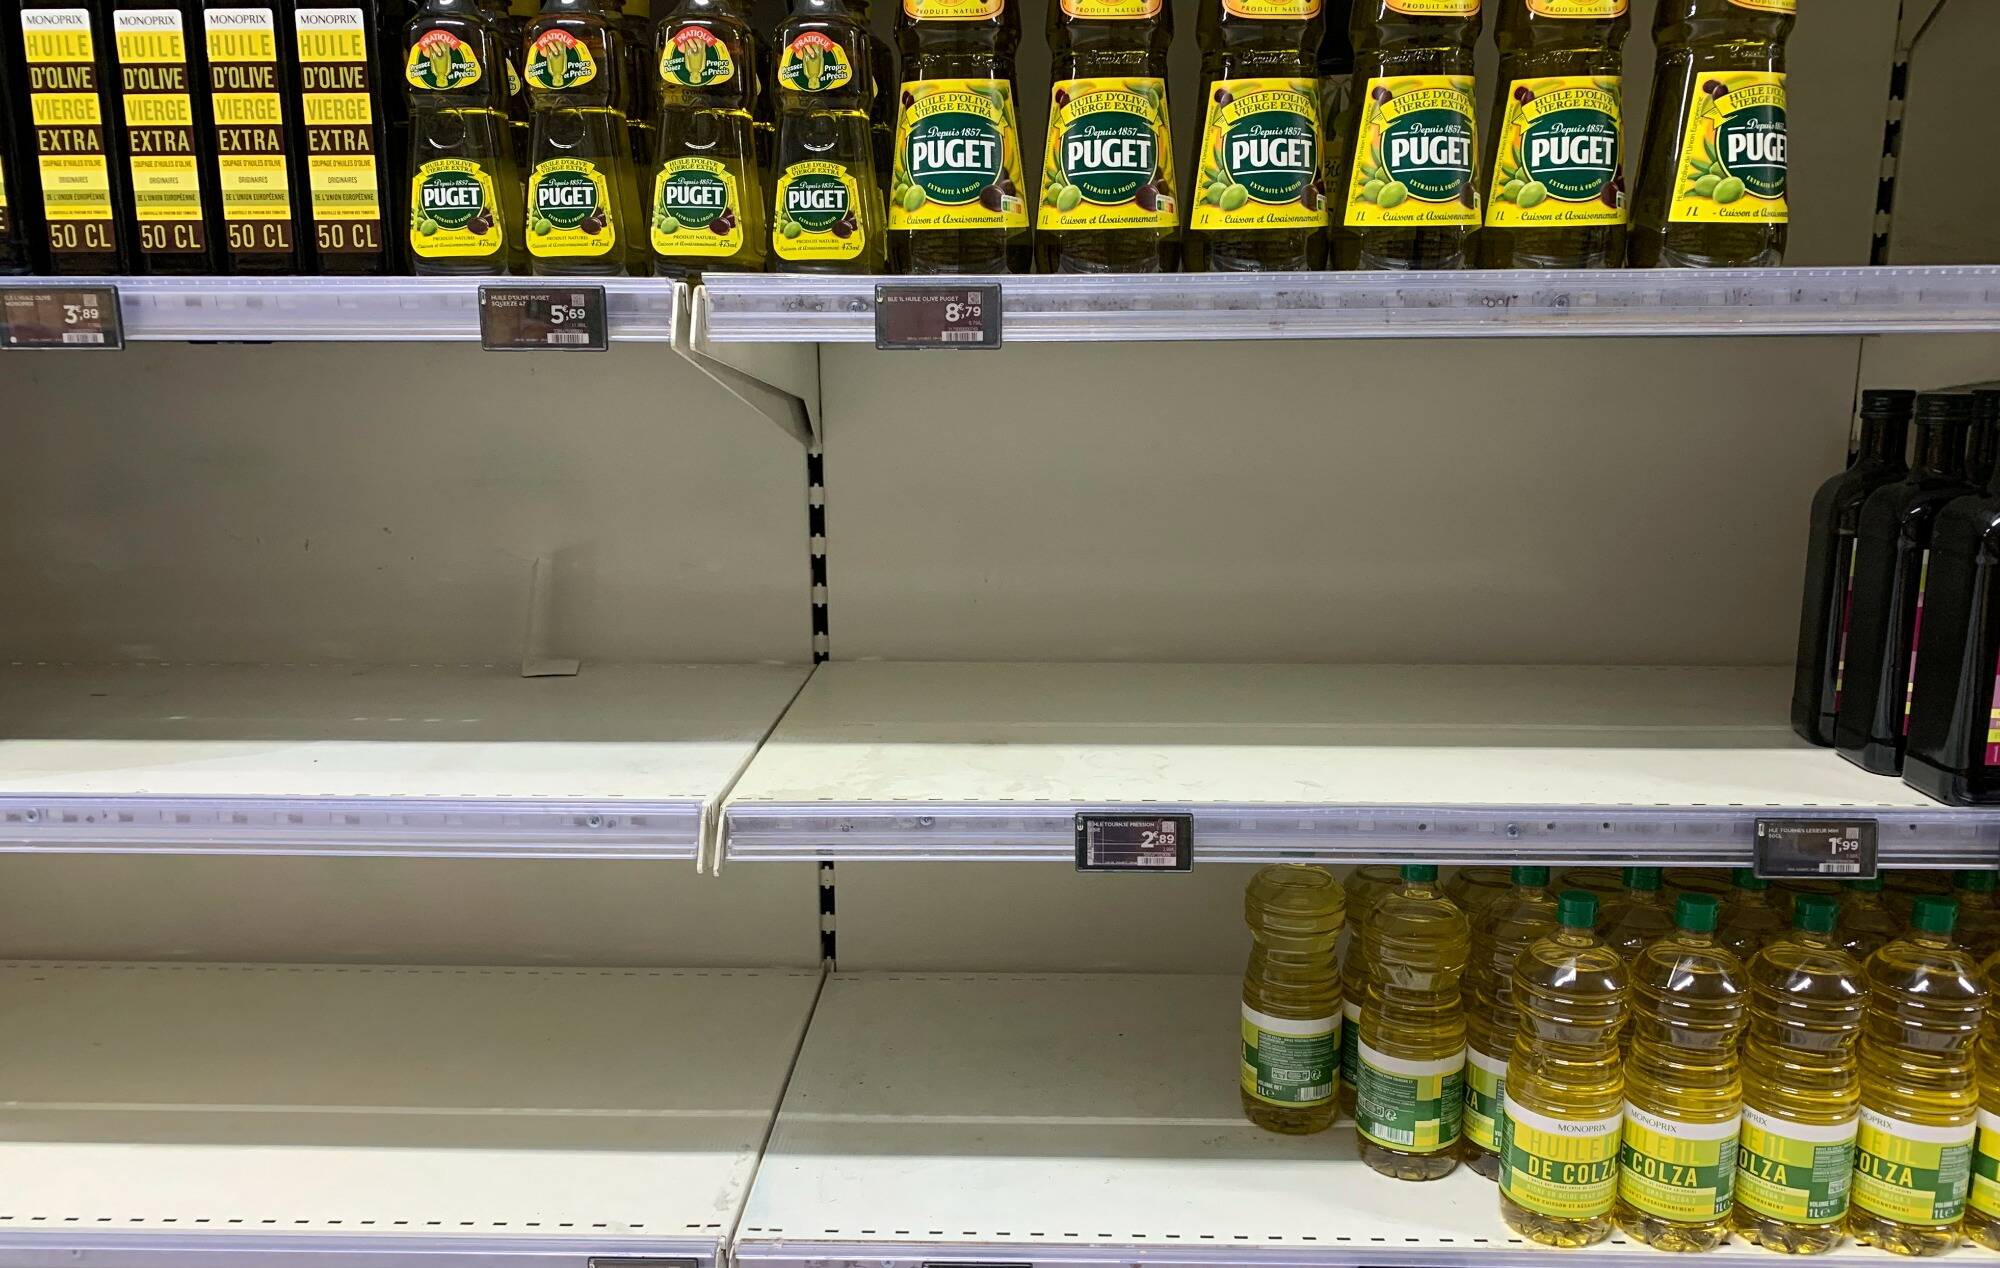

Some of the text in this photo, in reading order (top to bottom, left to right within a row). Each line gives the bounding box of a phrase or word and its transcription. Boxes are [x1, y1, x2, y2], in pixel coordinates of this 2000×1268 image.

[915, 7, 988, 15] PRODUIT NATUREL
[1075, 6, 1147, 14] PRODUIT NATUREL
[26, 15, 83, 25] MONOPRIX
[119, 15, 175, 26] MONOPRIX
[210, 14, 267, 25] MONOPRIX
[300, 14, 357, 25] MONOPRIX
[421, 33, 457, 48] PRATIQUE
[539, 32, 573, 47] PRATIQUE
[678, 30, 713, 44] PRATIQUE
[796, 36, 830, 49] PRATIQUE
[28, 35, 87, 57] HUILE
[120, 36, 180, 58] HUILE
[210, 34, 271, 57] HUILE
[300, 34, 362, 57] HUILE
[451, 62, 475, 71] Propre
[568, 61, 591, 70] Propre
[570, 68, 592, 77] Précis
[707, 60, 729, 69] Propre
[708, 67, 729, 76] Précis
[824, 64, 847, 73] Propre
[30, 66, 92, 89] D'OLIVE
[123, 67, 184, 90] D'OLIVE
[213, 66, 274, 89] D'OLIVE
[303, 66, 365, 89] D'OLIVE
[454, 69, 476, 78] Précis
[826, 71, 848, 80] Précis
[914, 92, 992, 112] HUILE D'OLIVE
[1070, 92, 1155, 112] HUILE D'OLIVE
[1234, 93, 1269, 110] HUILE
[1393, 91, 1430, 107] HUILE
[1535, 90, 1614, 108] HUILE D'OLIVE
[1730, 87, 1764, 103] HUILE
[36, 98, 96, 121] VIERGE
[127, 99, 188, 121] VIERGE
[216, 98, 278, 121] VIERGE
[307, 98, 368, 121] VIERGE
[915, 102, 991, 119] VIERGE EXTRA
[1071, 101, 1148, 119] VIERGE EXTRA
[1234, 101, 1309, 117] VIERGE EXTRA
[1394, 99, 1468, 114] VIERGE EXTRA
[1536, 99, 1613, 114] VIERGE EXTRA
[1731, 96, 1771, 111] VIERGE
[927, 126, 981, 139] Depuis 1857
[1084, 125, 1138, 139] Depuis 1857
[1250, 125, 1302, 138] Depuis 1857
[1410, 123, 1461, 136] Depuis 1857
[1551, 123, 1604, 136] Depuis 1857
[38, 129, 100, 152] EXTRA
[130, 130, 190, 152] EXTRA
[218, 129, 280, 151] EXTRA
[308, 129, 370, 151] EXTRA
[913, 139, 995, 170] PUGET
[1068, 138, 1151, 170] PUGET
[1232, 138, 1312, 169] PUGET
[1392, 136, 1471, 167] PUGET
[1531, 136, 1615, 167] PUGET
[800, 181, 820, 190] Depuis
[927, 182, 955, 195] EXTRAITE
[962, 181, 981, 194] FROID
[1083, 182, 1111, 195] EXTRAITE
[1118, 181, 1137, 194] FROID
[1549, 178, 1578, 191] EXTRAITE
[1585, 178, 1602, 190] FROID
[424, 187, 479, 207] PUGET
[539, 187, 594, 206] PUGET
[666, 186, 723, 205] PUGET
[789, 190, 846, 210] PUGET
[906, 213, 1004, 225] Cuisson et Assaisonnement
[1060, 213, 1158, 225] Cuisson et Assaisonnement
[1200, 214, 1209, 224] 1L
[1224, 213, 1265, 224] Cuisson et
[1356, 212, 1365, 221] 1L
[1382, 211, 1423, 222] Cuisson et
[1495, 211, 1505, 221] 1L
[1521, 211, 1553, 221] Cuisson
[1554, 210, 1563, 220] et
[1685, 206, 1699, 216] 1L
[1719, 207, 1751, 217] Cuisson
[1042, 215, 1049, 225] 1L
[51, 224, 111, 248] 50 CL
[141, 225, 200, 249] 50 CL
[229, 224, 289, 248] 50 CL
[318, 224, 344, 248] 50
[352, 224, 378, 248] CL
[1558, 1123, 1607, 1133] MONOPRIX
[1631, 1109, 1677, 1133] MONOPRIX
[1531, 1129, 1599, 1161] HUILE
[1528, 1155, 1616, 1184] DE COLZA
[1632, 1152, 1697, 1187] COLZA
[1739, 1148, 1787, 1185] OLZA
